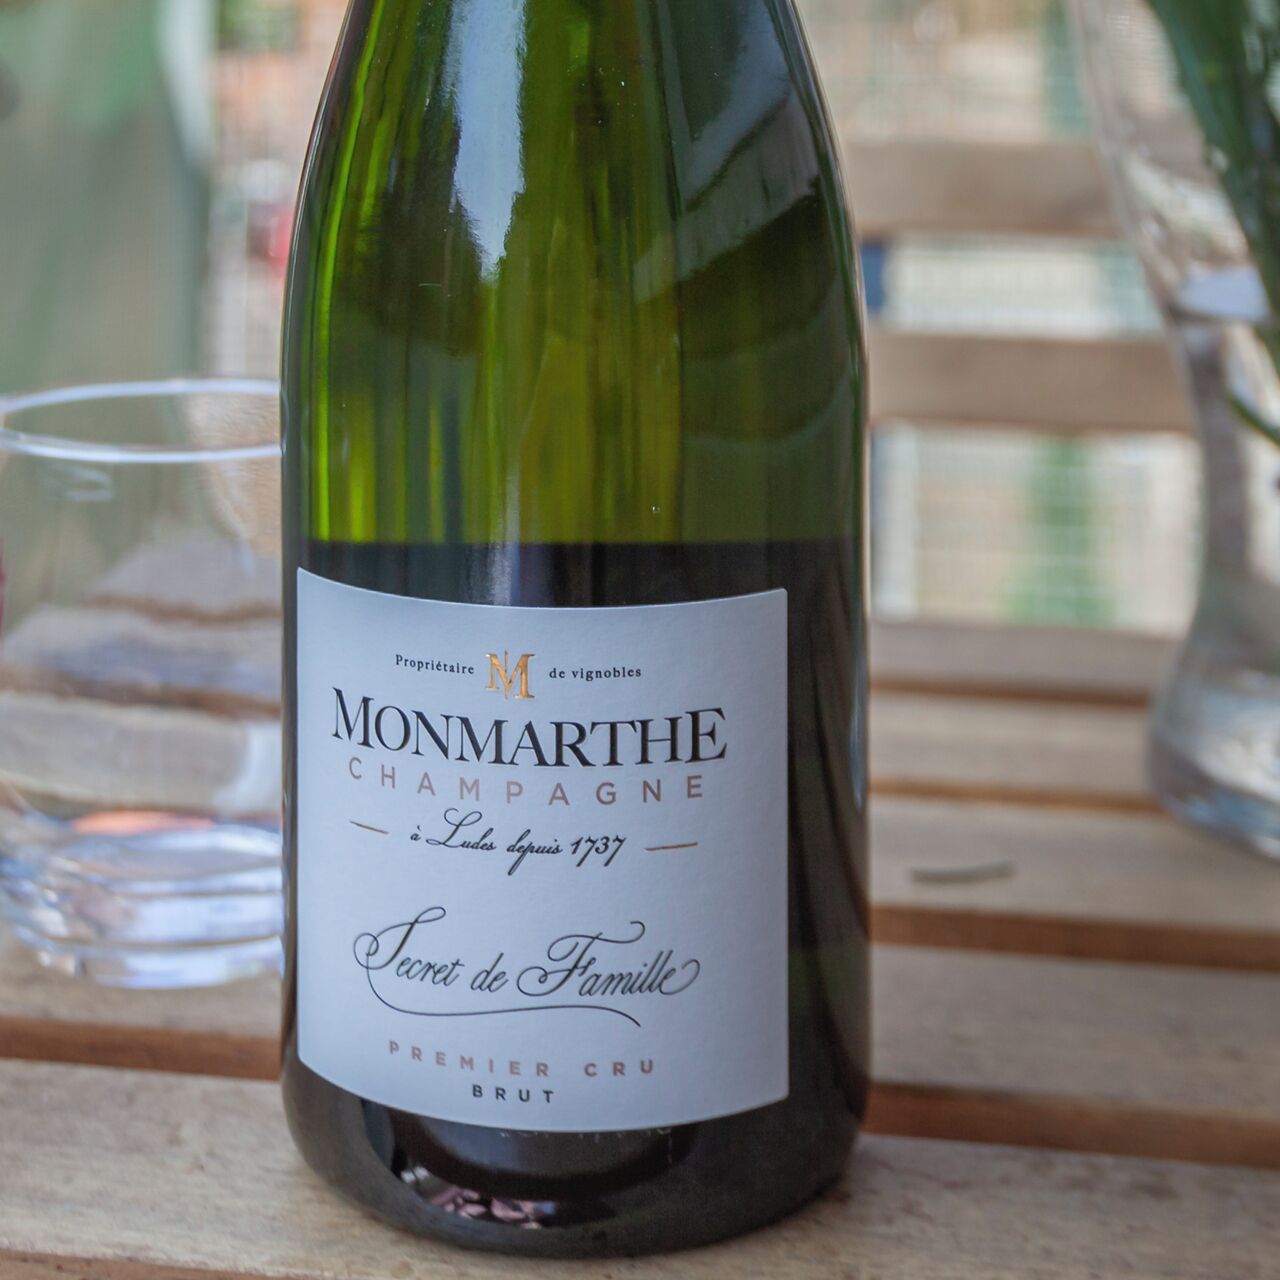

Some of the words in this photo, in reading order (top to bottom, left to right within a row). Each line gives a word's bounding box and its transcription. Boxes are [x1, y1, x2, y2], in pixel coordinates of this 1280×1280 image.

[395, 653, 475, 676] Propriétaire
[548, 667, 567, 680] de
[571, 666, 642, 682] vignobles
[331, 686, 729, 768] MONMARTHE
[348, 756, 704, 807] CHAMPAGNE
[425, 807, 497, 851] Ludes
[505, 828, 563, 876] depuis
[570, 834, 628, 868] 1737
[353, 906, 466, 987] Secret
[470, 952, 509, 993] de
[516, 920, 701, 997] Famille
[389, 1039, 550, 1077] PREMIER
[583, 1059, 654, 1077] CRU
[472, 1084, 555, 1104] BRUT
